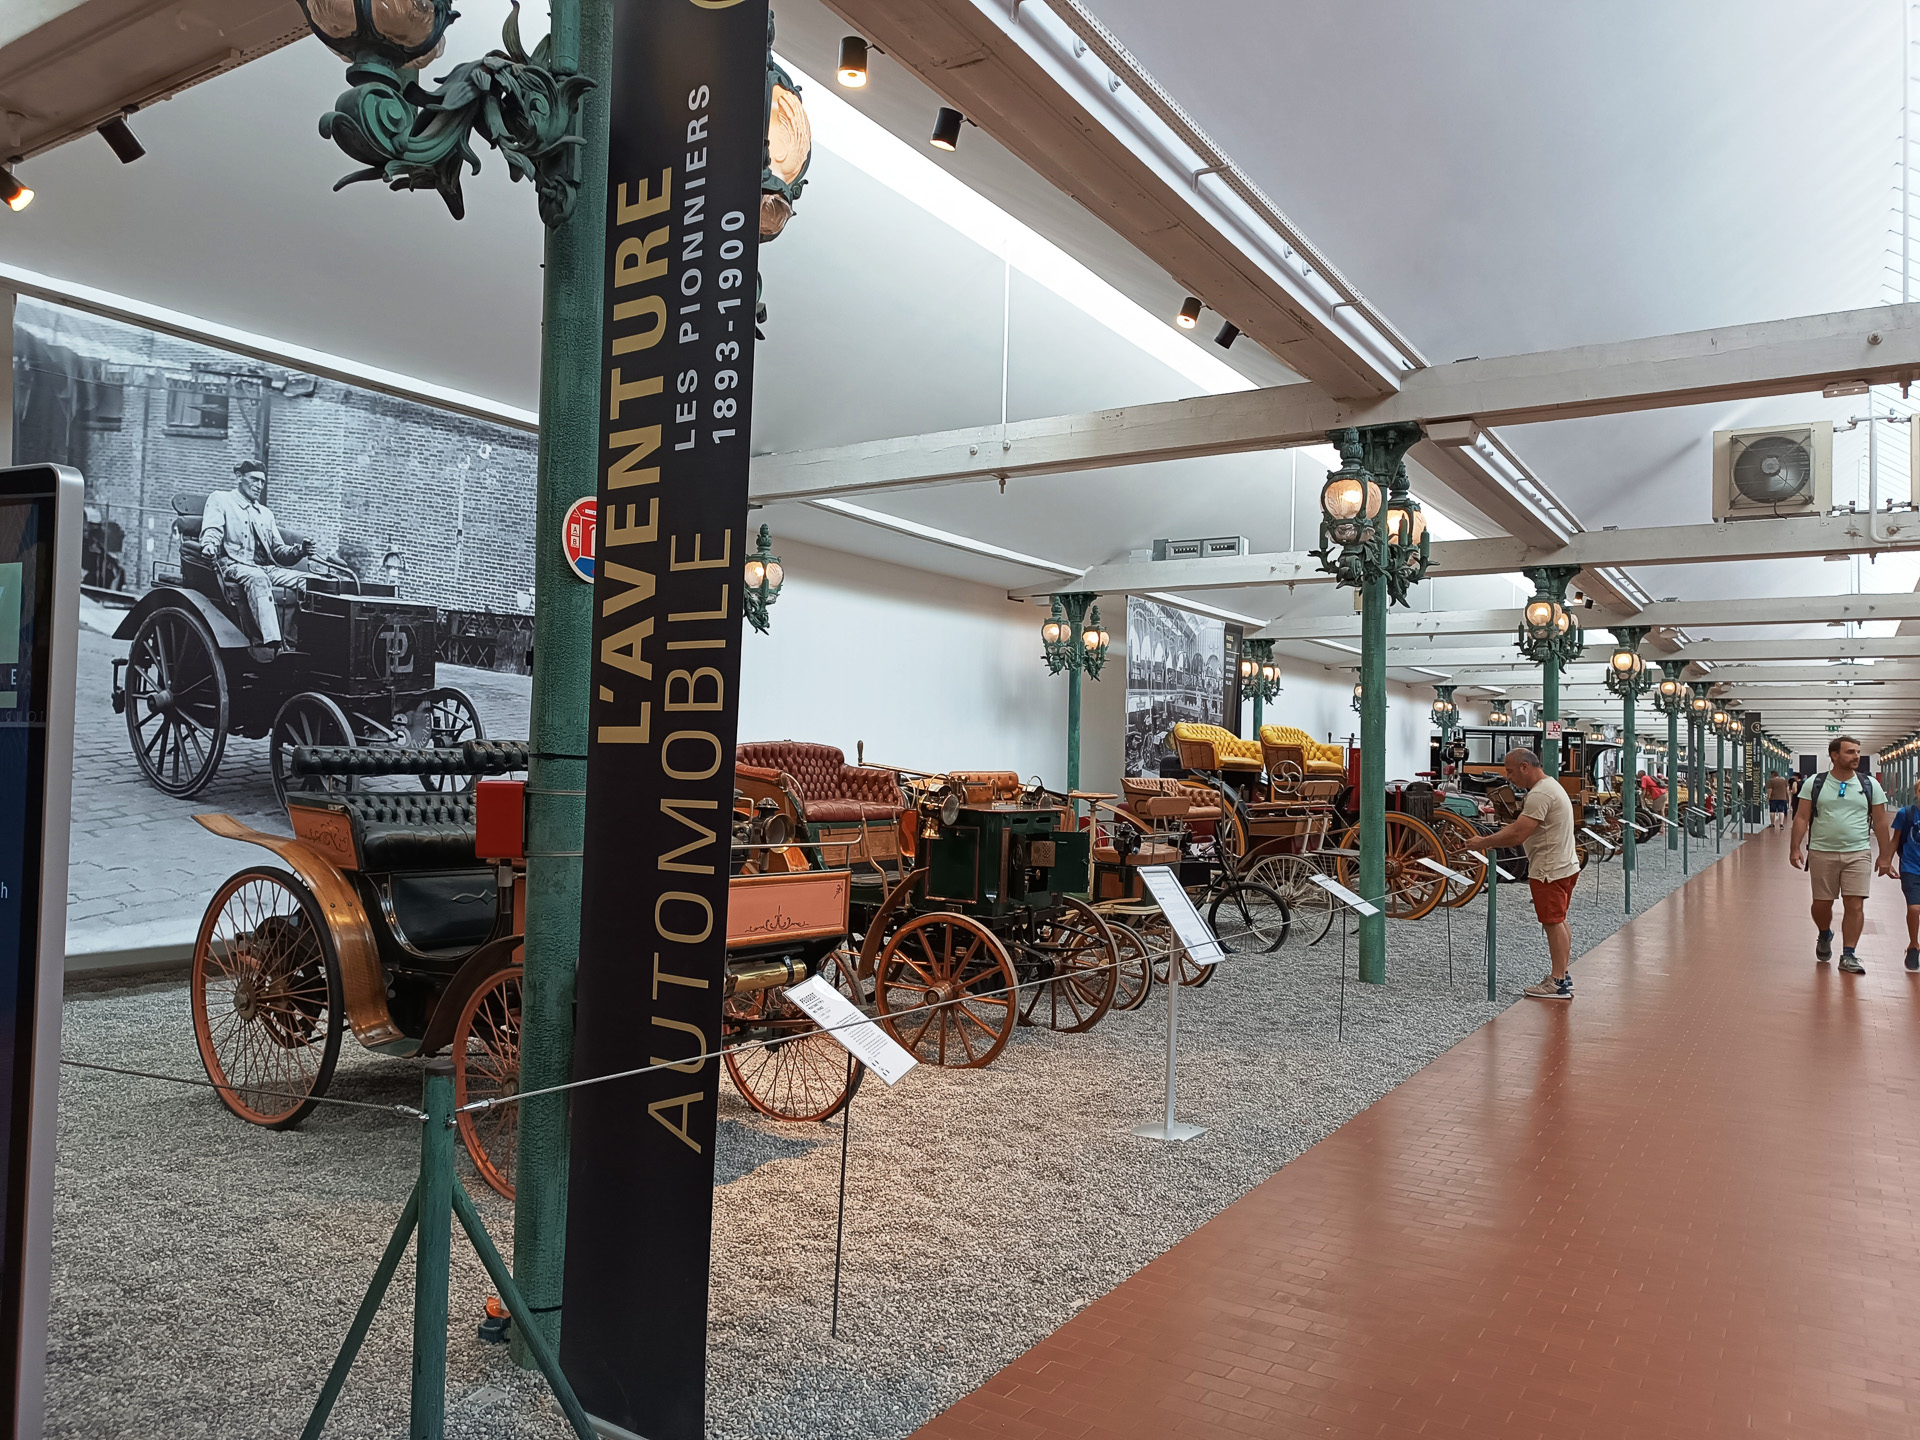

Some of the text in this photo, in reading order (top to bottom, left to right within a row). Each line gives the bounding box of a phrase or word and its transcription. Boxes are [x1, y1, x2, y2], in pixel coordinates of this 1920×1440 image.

[674, 84, 711, 453] LES PIONNIERS
[712, 210, 746, 445] 1893-1900
[597, 166, 673, 746] L'AVENTURE
[647, 528, 732, 1154] AUTOMOBILE
[1753, 766, 1761, 806] AUTOMOBILE
